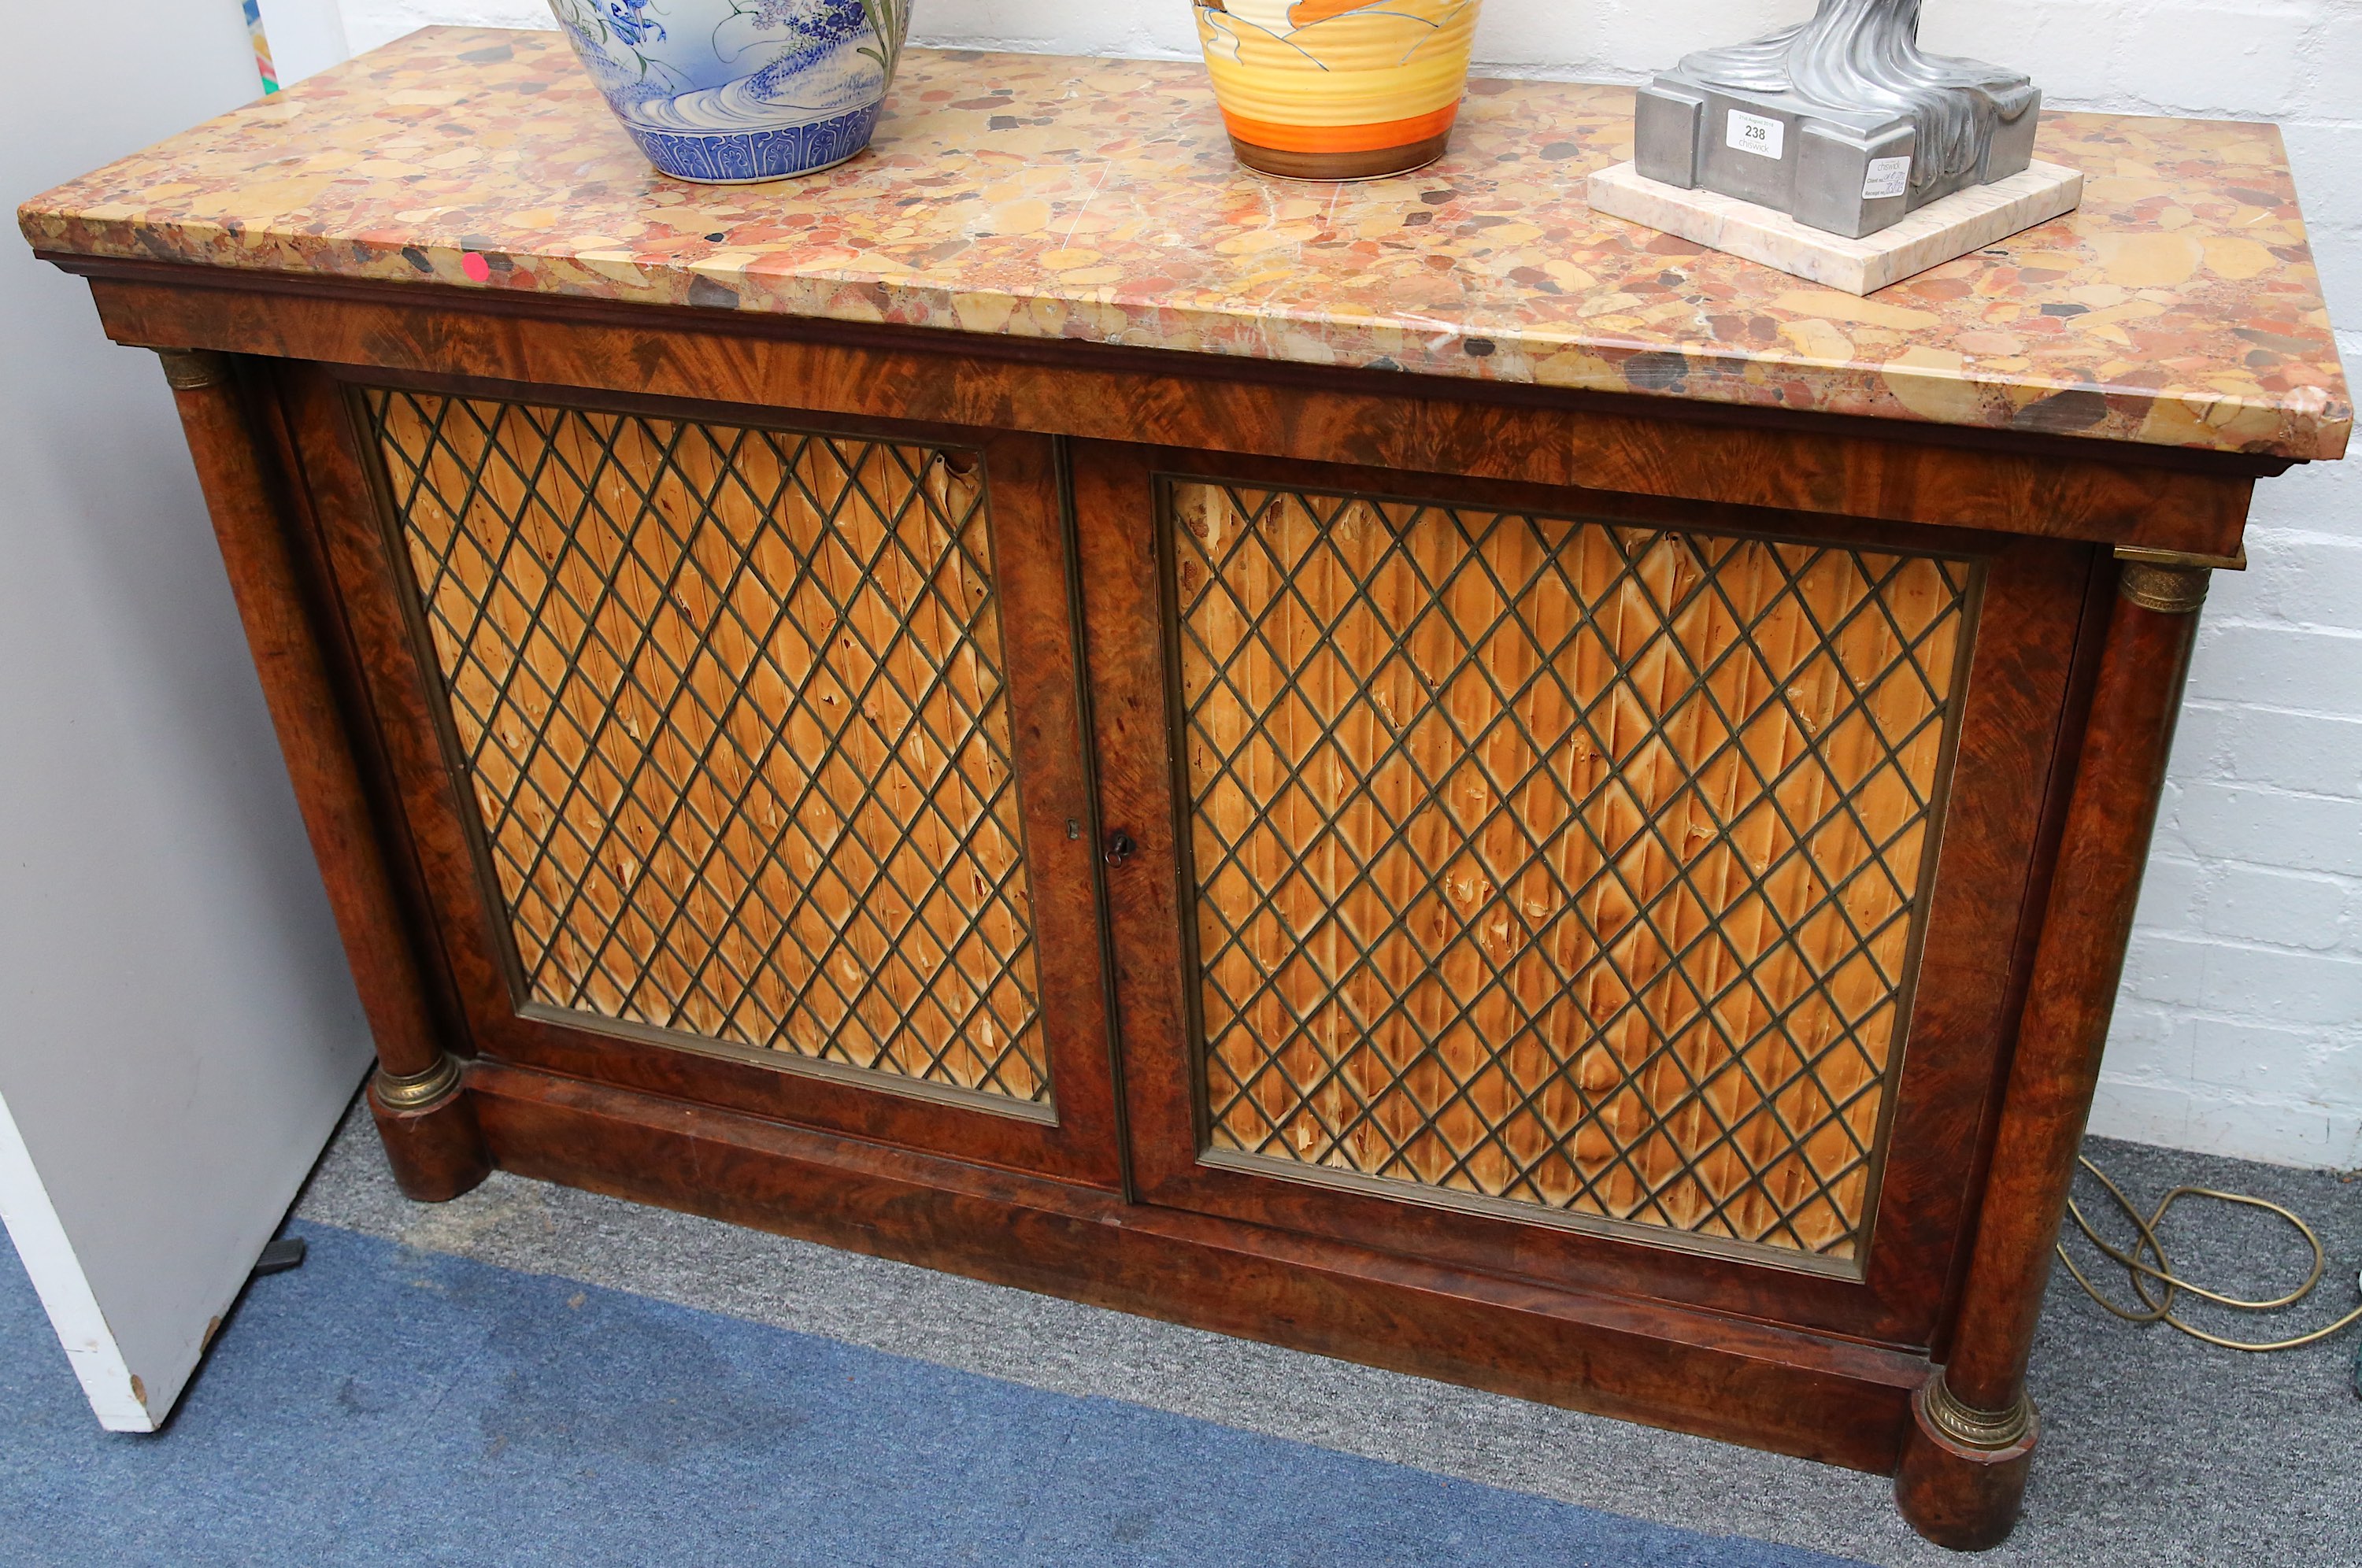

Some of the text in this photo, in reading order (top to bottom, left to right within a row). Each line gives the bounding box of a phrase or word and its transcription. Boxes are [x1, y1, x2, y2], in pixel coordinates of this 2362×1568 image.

[1749, 116, 1763, 125] August
[1745, 125, 1765, 140] 238
[1738, 138, 1769, 153] chiswick
[1877, 161, 1900, 171] chiswick
